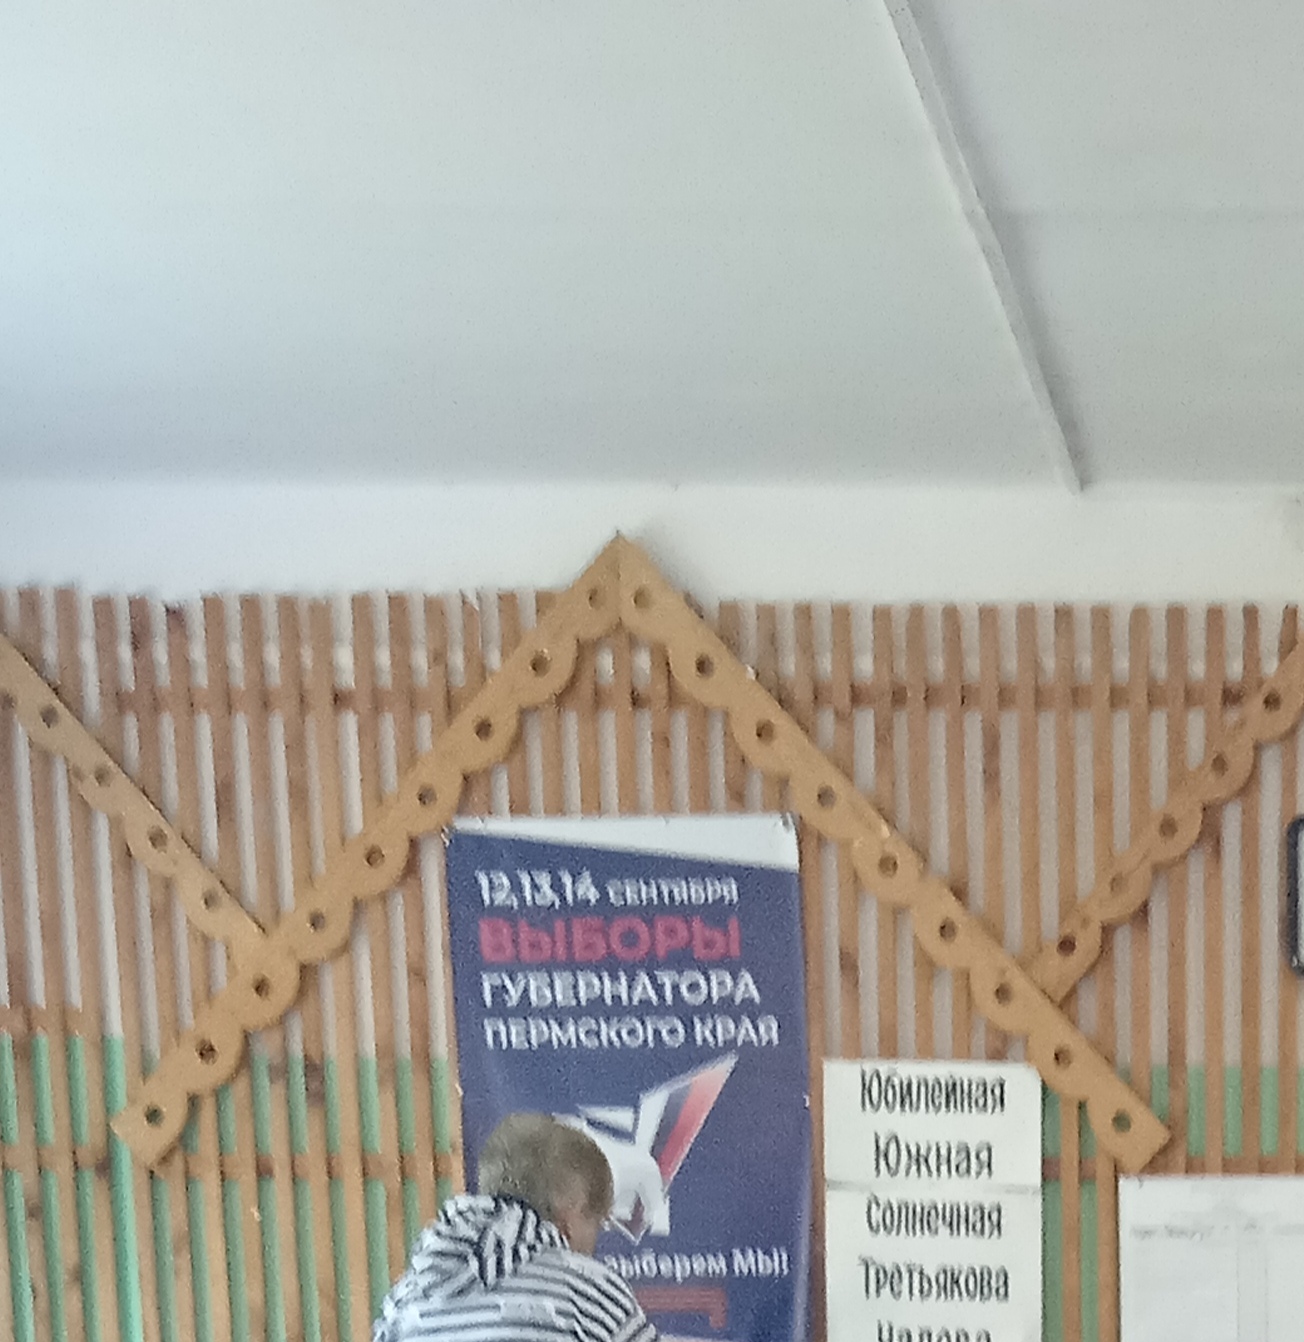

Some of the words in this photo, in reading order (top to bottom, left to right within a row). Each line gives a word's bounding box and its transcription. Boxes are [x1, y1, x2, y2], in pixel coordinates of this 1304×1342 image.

[475, 867, 600, 909] 12,13,14
[478, 914, 741, 964] ВЫБОРЫ
[481, 967, 761, 1008] ГУБЕРНАТОРА
[484, 1015, 686, 1050] ПЕРМСКОГО
[693, 1014, 781, 1049] КРАЯ
[860, 1066, 1006, 1116] Юбилейная
[874, 1130, 993, 1179] Южная
[866, 1192, 1003, 1239] Солнечная
[858, 1254, 1010, 1302] Третьякова
